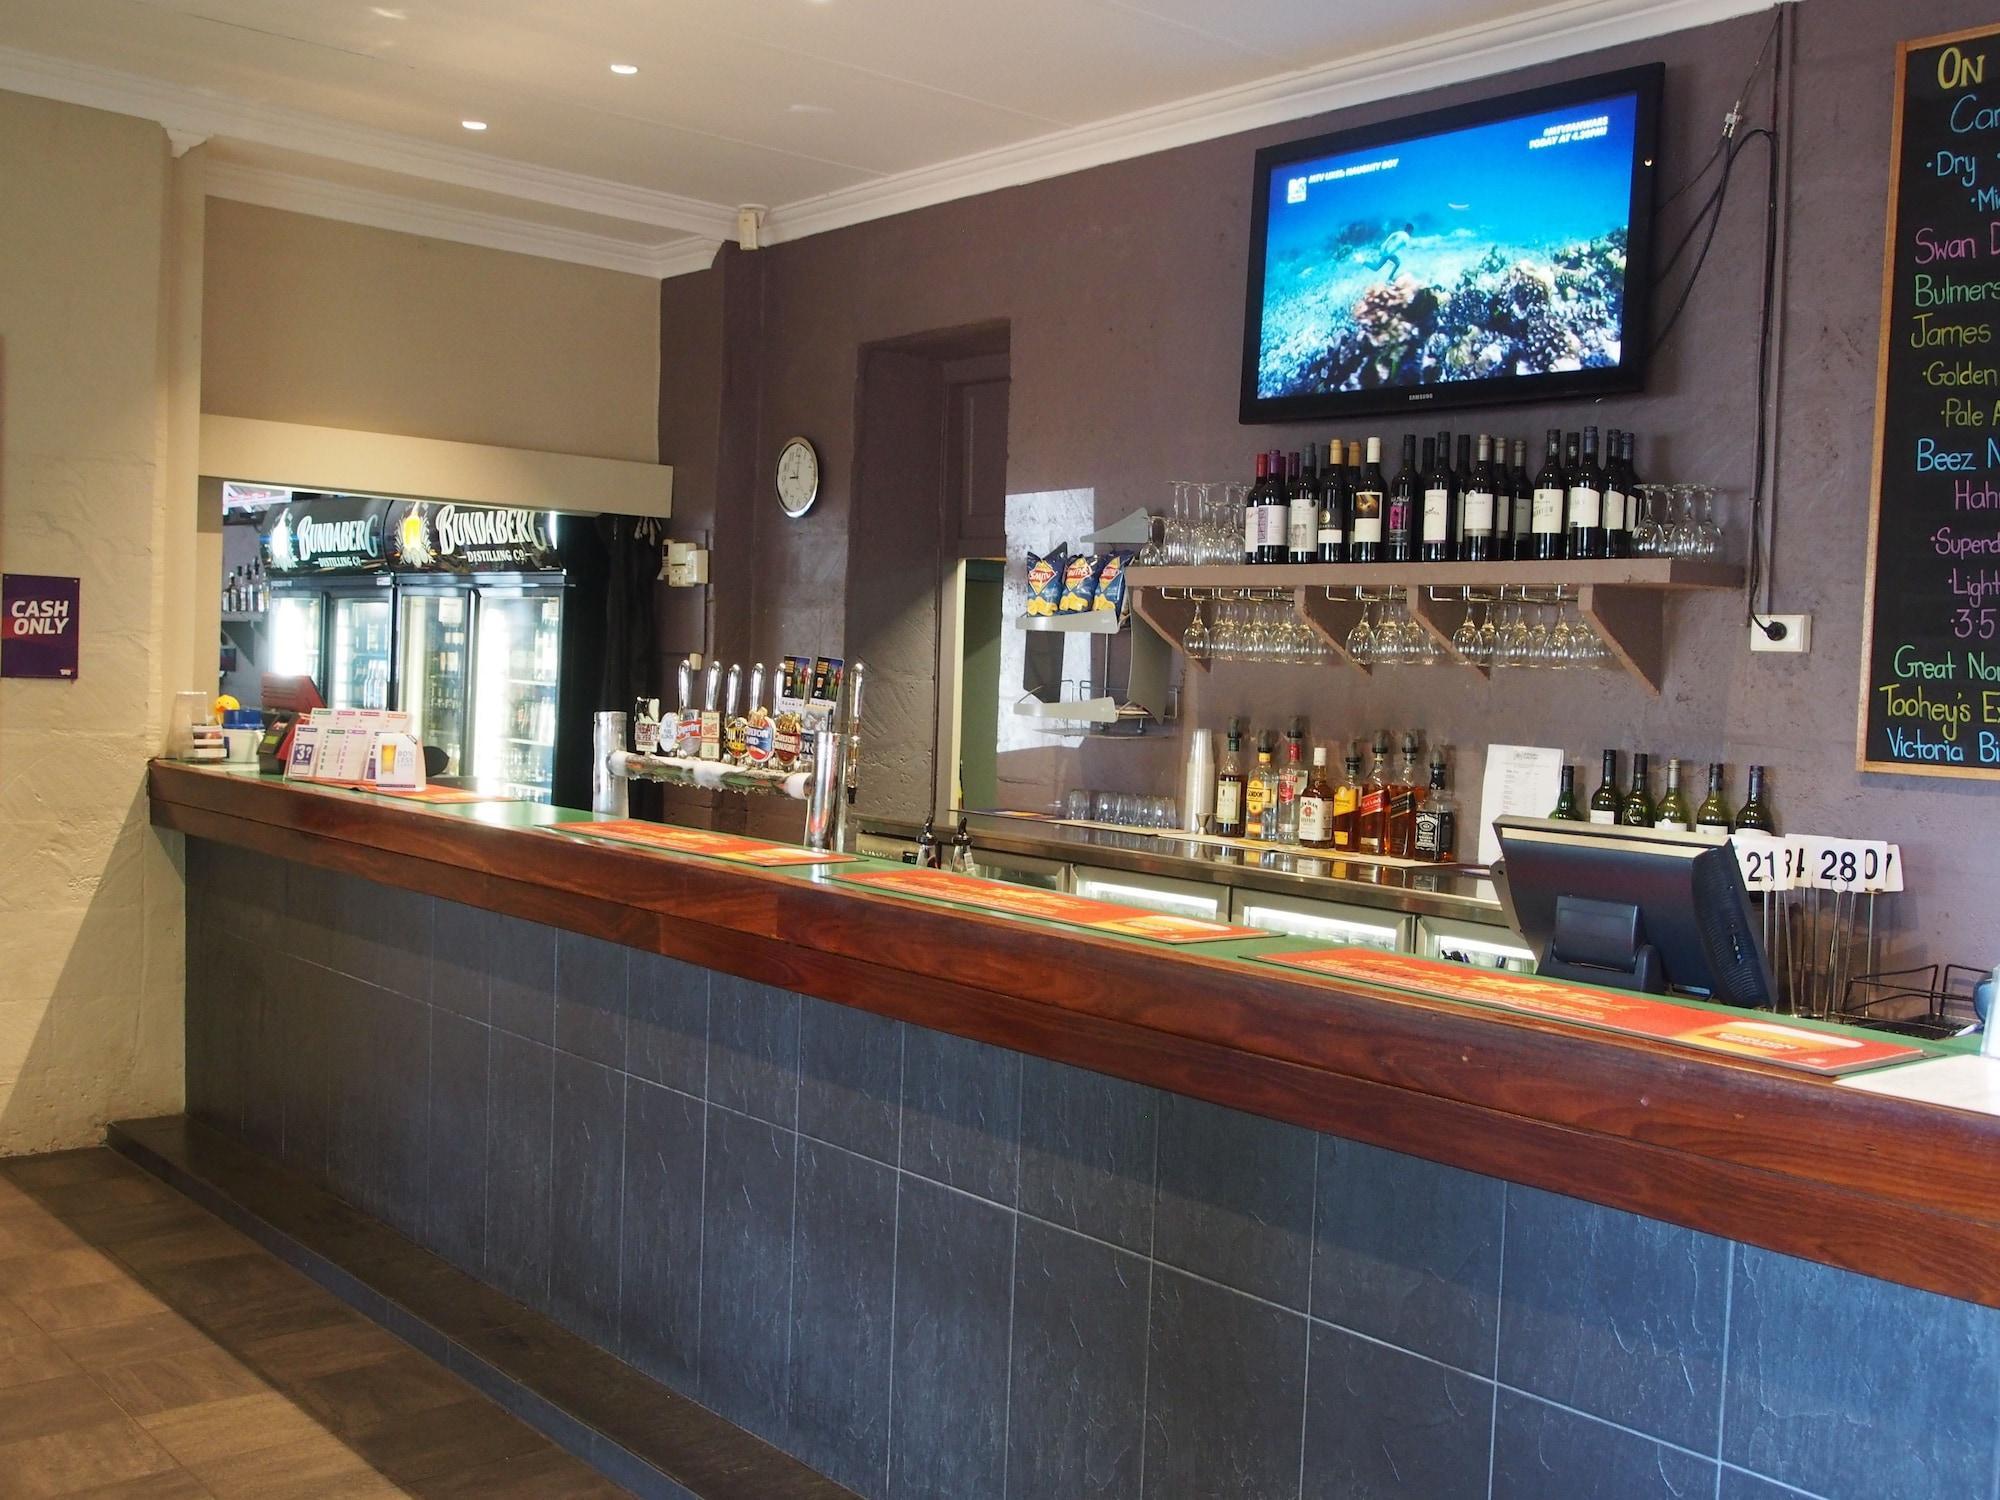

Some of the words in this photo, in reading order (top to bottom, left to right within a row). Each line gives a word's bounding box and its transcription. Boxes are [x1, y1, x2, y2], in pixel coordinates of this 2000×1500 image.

[1936, 150, 1976, 188] Dry
[1914, 227, 1977, 265] Swan
[1910, 312, 1992, 348] James
[1926, 360, 1998, 387] Golden
[1945, 397, 1985, 428] Pale
[1916, 437, 1977, 472] Beez
[297, 514, 379, 562] BUNDABERG
[435, 503, 549, 555] BUNDABERG
[317, 556, 353, 569] DISTILLING
[466, 549, 516, 564] DISTILLING
[11, 600, 70, 618] CASH
[13, 617, 70, 636] ONLY
[1893, 644, 1957, 680] Great
[1878, 682, 1972, 742] Toohey's
[1886, 726, 1965, 763] Victoria
[1746, 851, 1775, 882] 21
[1820, 849, 1857, 882] 28
